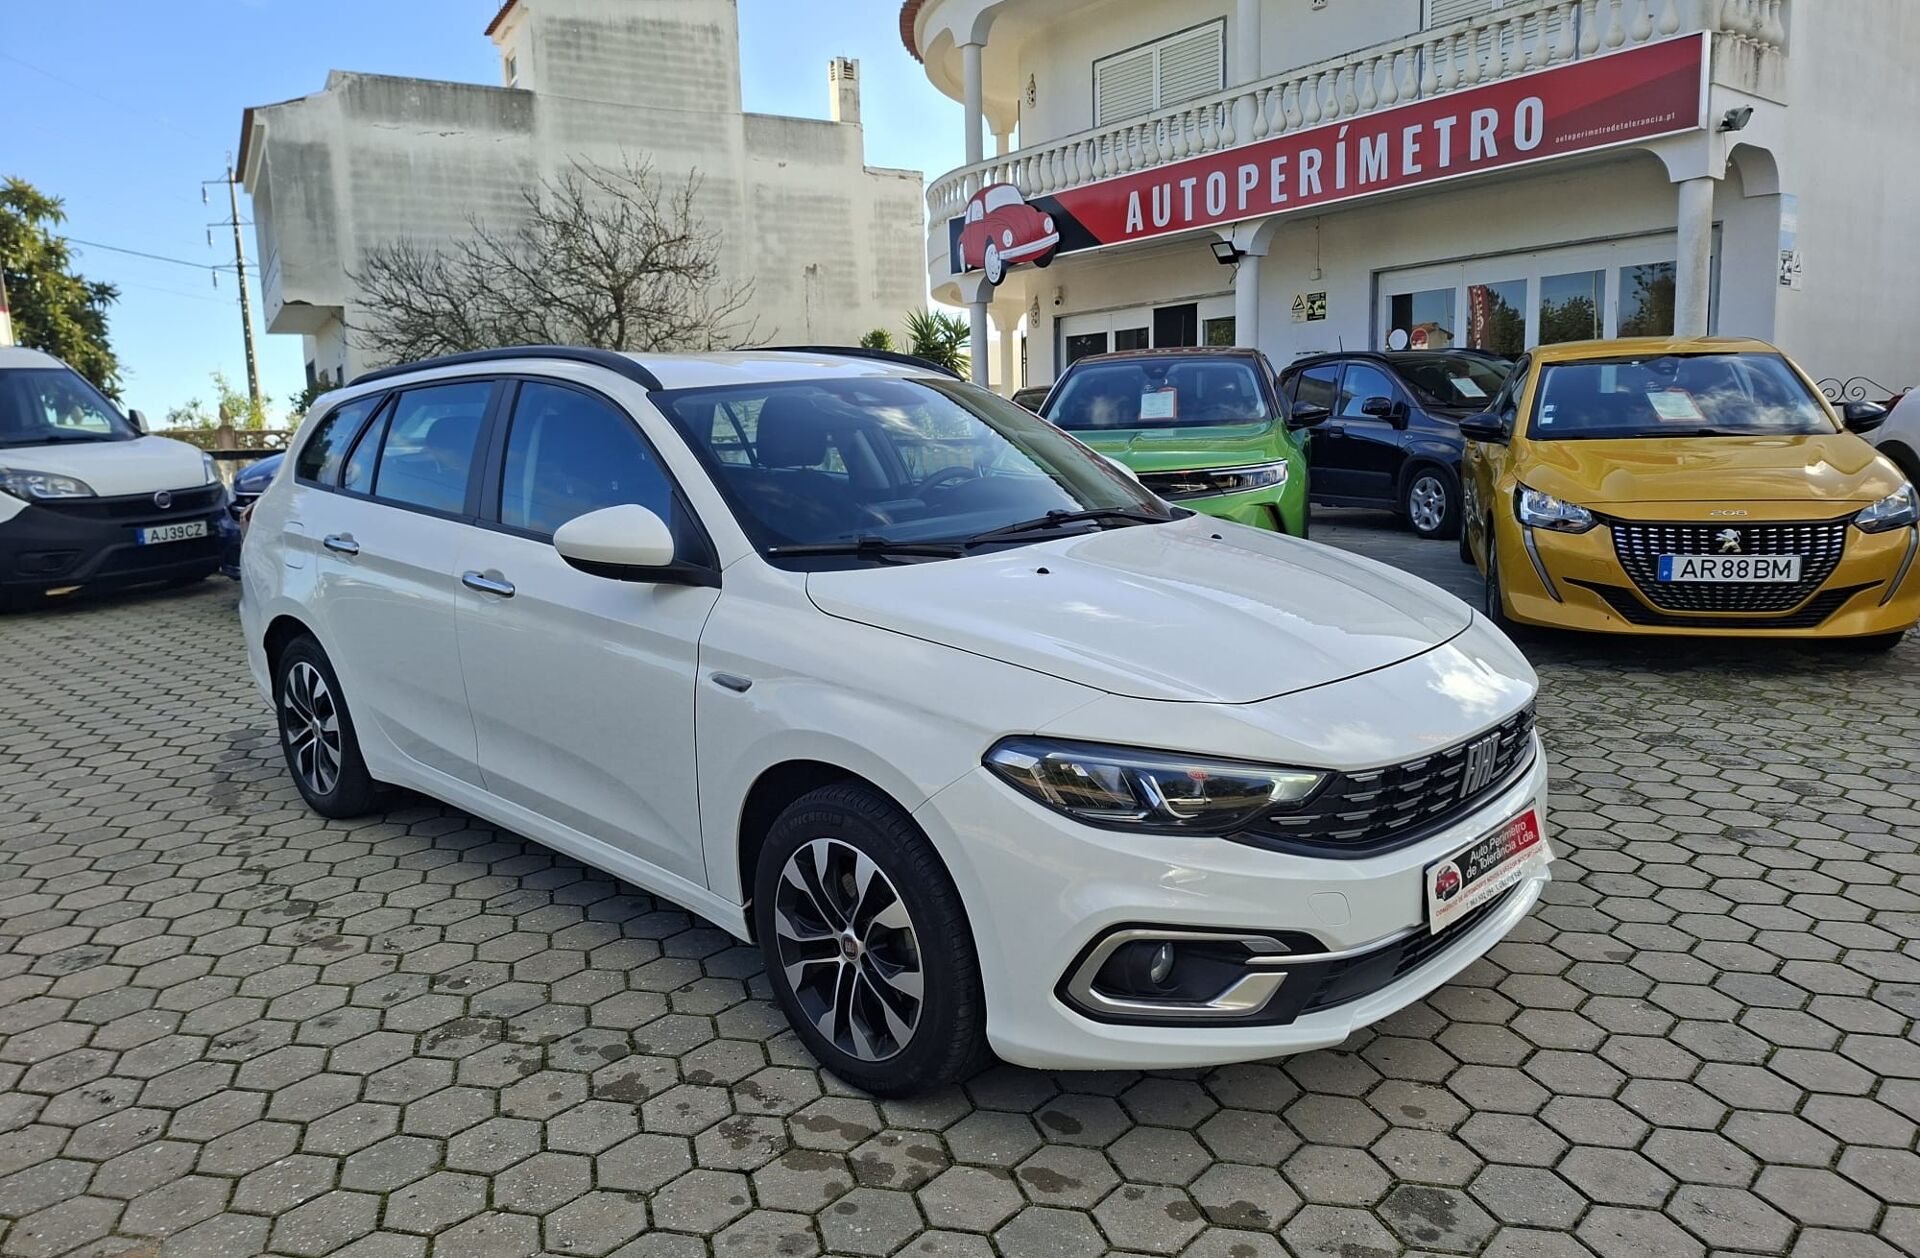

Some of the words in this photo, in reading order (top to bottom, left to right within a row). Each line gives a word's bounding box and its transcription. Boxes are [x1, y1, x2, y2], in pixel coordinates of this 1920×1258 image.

[1125, 95, 1545, 234] AUTOPERÍMETRO
[1460, 732, 1501, 798] FIAT
[1466, 865, 1477, 879] de
[1469, 845, 1488, 864] Auto
